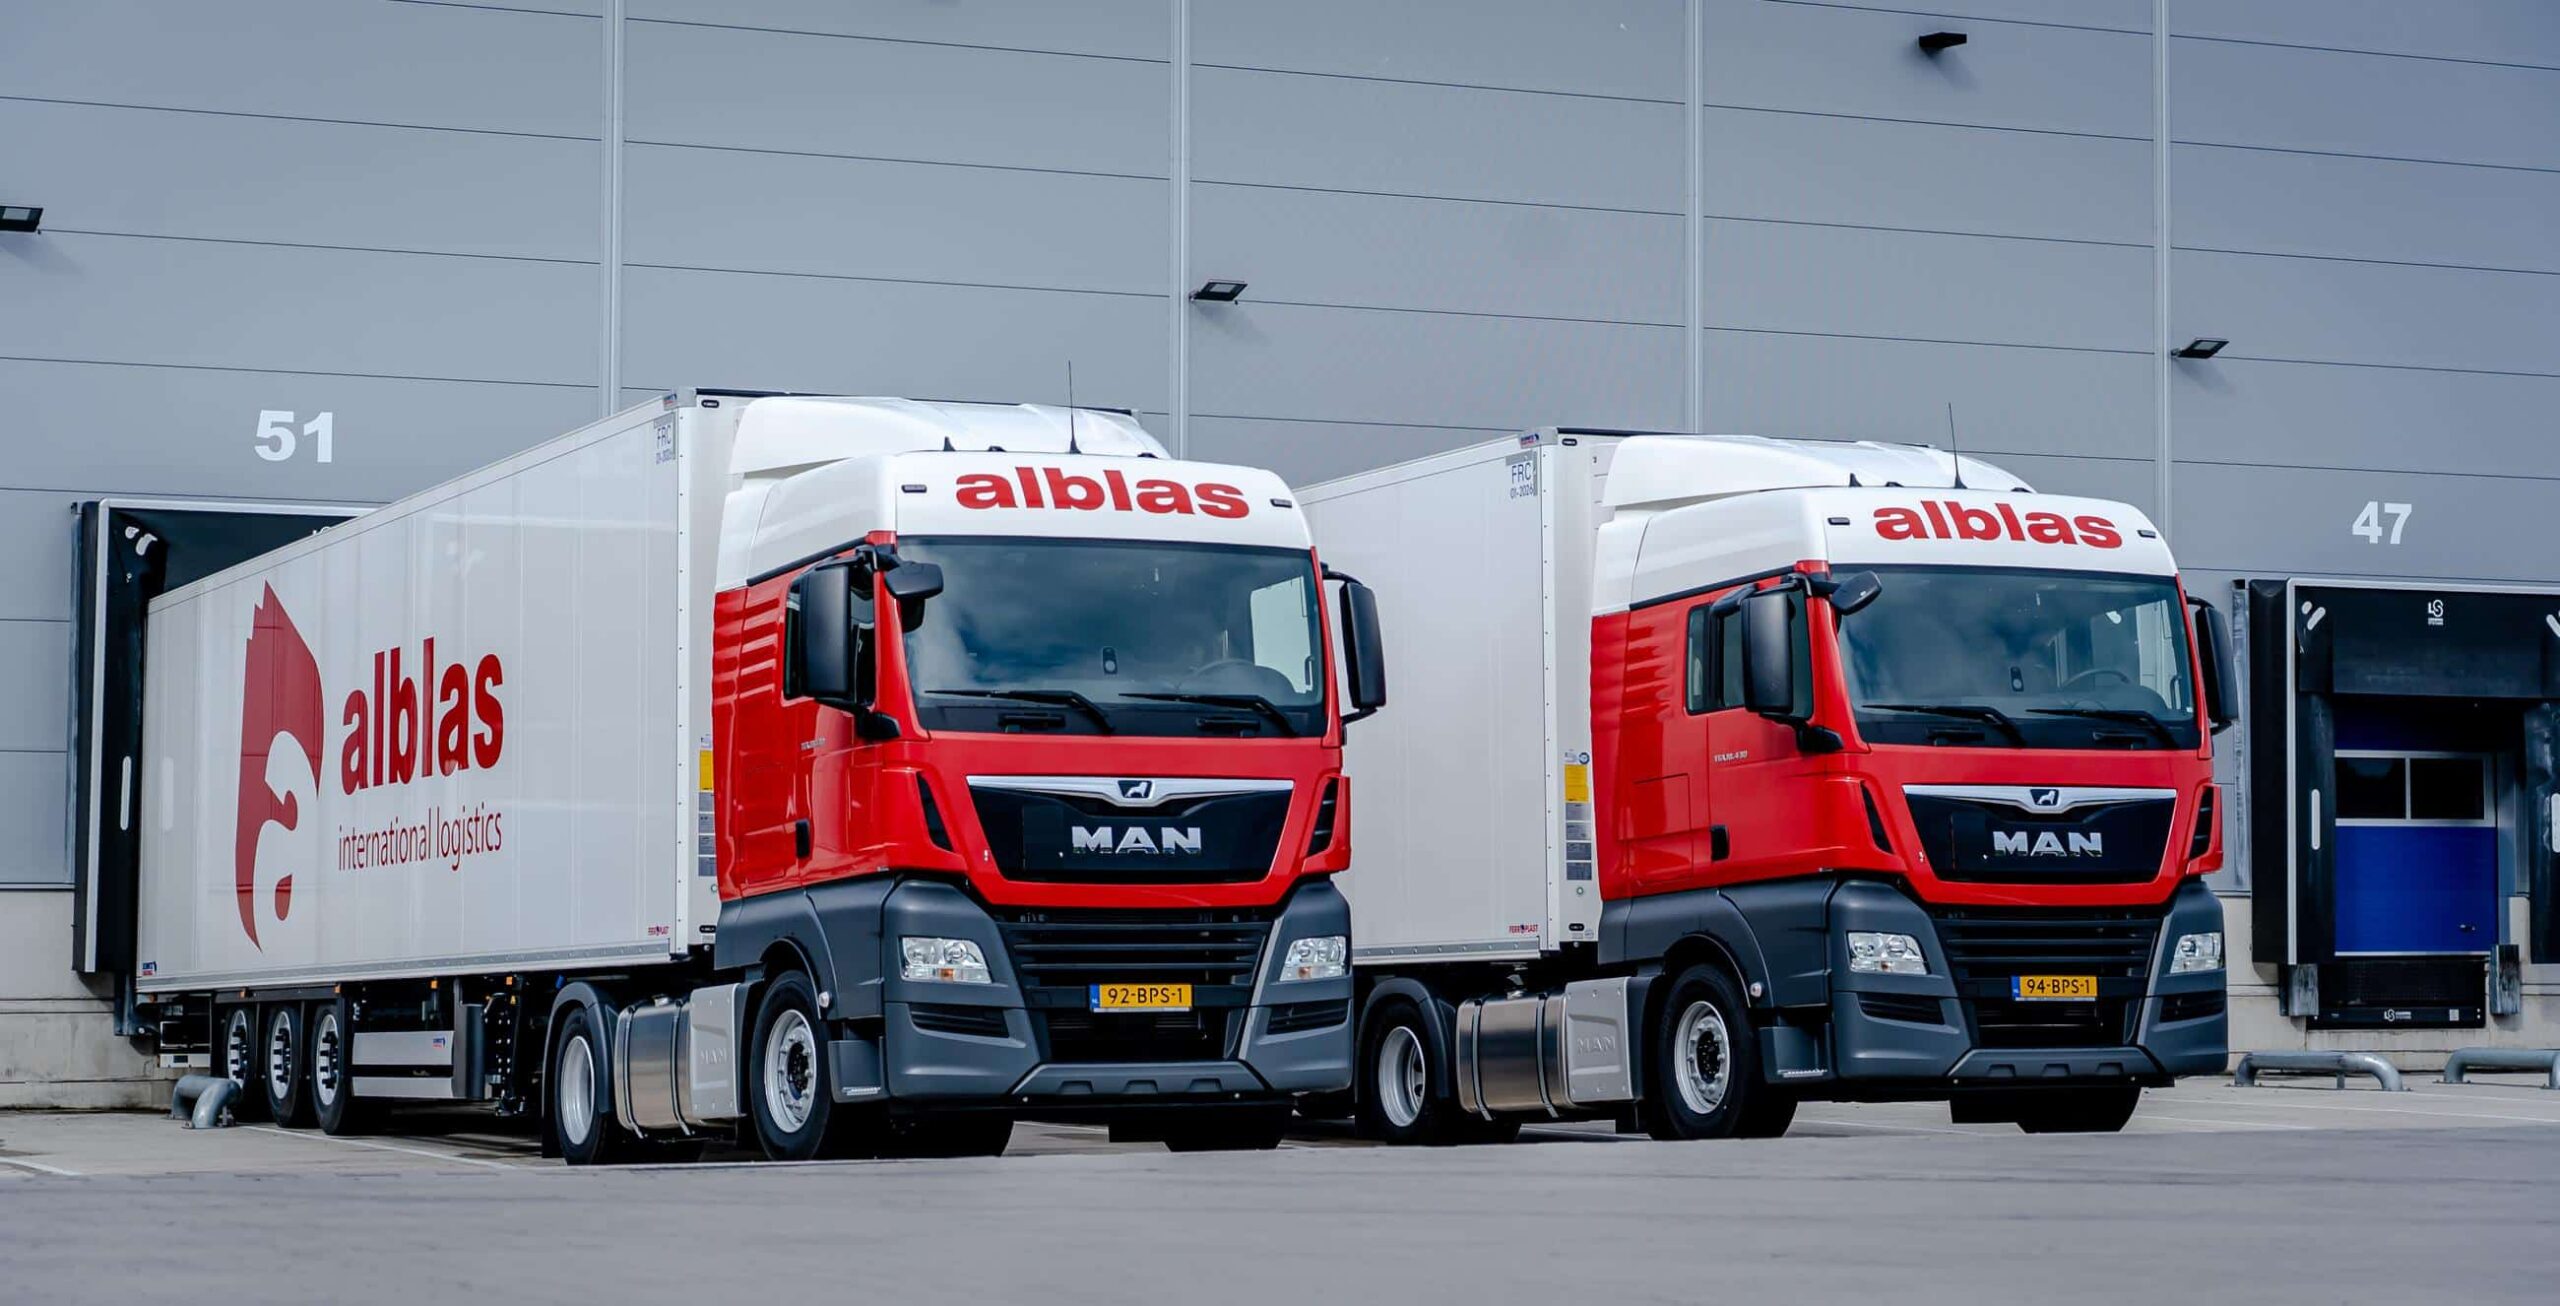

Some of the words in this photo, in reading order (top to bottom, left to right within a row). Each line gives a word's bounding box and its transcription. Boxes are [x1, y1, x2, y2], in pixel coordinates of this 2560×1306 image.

[255, 409, 333, 463] 51
[956, 466, 1250, 519] alblas
[1511, 461, 1532, 484] FRC
[1873, 500, 2122, 549] alblas
[2352, 500, 2412, 545] 47
[341, 636, 503, 796] alblas
[338, 807, 431, 872] international
[436, 801, 502, 872] logistics
[1071, 826, 1201, 854] MAN
[1992, 831, 2102, 857] MAN
[1108, 987, 1182, 1004] 92-BPS-1
[2027, 979, 2090, 994] 94-BPS-1
